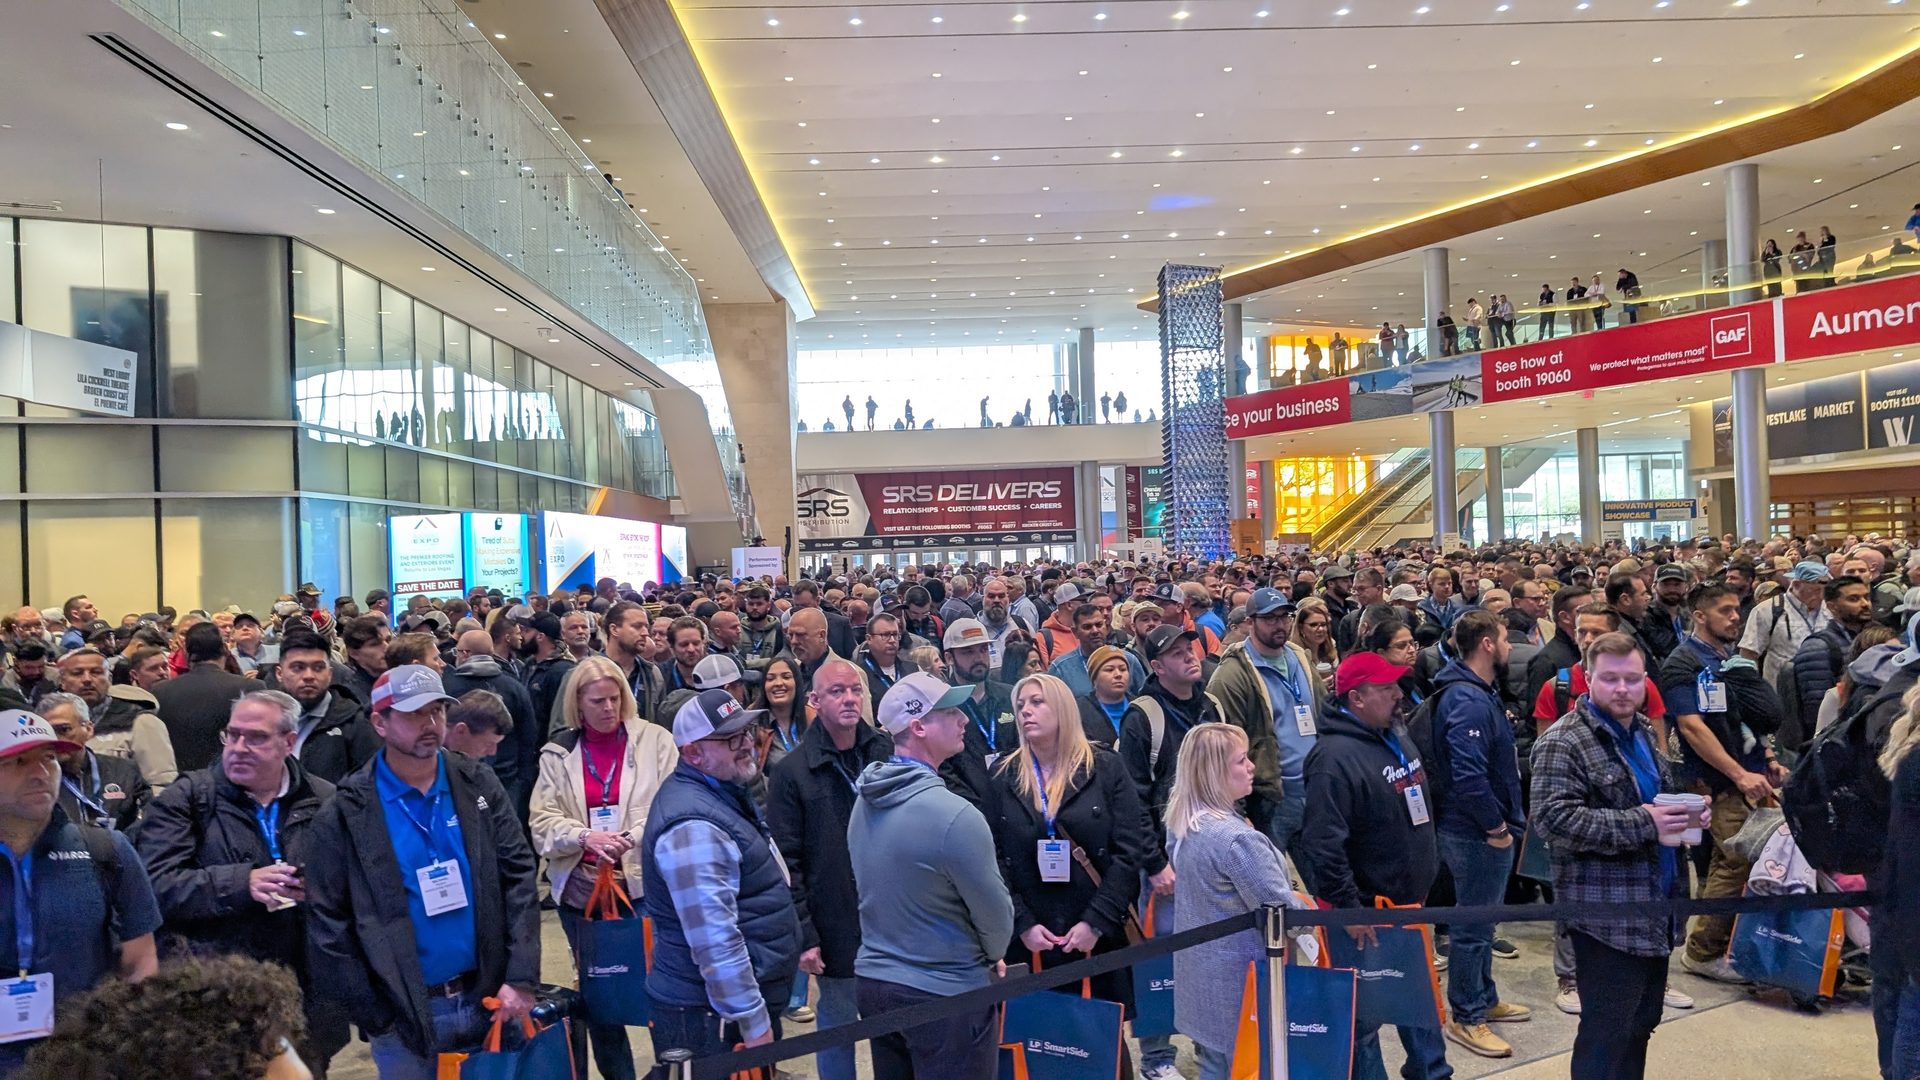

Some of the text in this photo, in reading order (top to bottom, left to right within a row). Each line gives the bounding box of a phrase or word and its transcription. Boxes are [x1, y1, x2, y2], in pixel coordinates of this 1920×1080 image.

[1715, 326, 1747, 345] GAF
[1495, 350, 1564, 373] See how at
[1589, 363, 1602, 372] We
[1602, 358, 1630, 372] protect
[1630, 354, 1650, 366] what
[1651, 350, 1683, 362] matters
[1496, 368, 1572, 392] booth 19060
[1813, 401, 1855, 420] MARKET
[1870, 397, 1900, 411] BOOTH
[1242, 407, 1273, 428] your
[1276, 397, 1340, 420] business
[882, 481, 1062, 503] SRS DELIVERS
[797, 498, 850, 518] SRS
[883, 502, 1062, 515] RELATIONSHIPS CUSTOMER SUCCESS CAREERS
[1605, 500, 1694, 510] INNOVATIVE PRODUCT
[1605, 511, 1651, 520] SHOWCASE
[481, 567, 519, 576] Your Projects?
[397, 580, 460, 593] SAVE THE DATE
[1360, 968, 1404, 977] SmartSide
[1151, 980, 1162, 988] LP
[1289, 1022, 1329, 1033] SmartSide
[1029, 1040, 1041, 1048] LP
[1043, 1041, 1089, 1058] SmartSide
